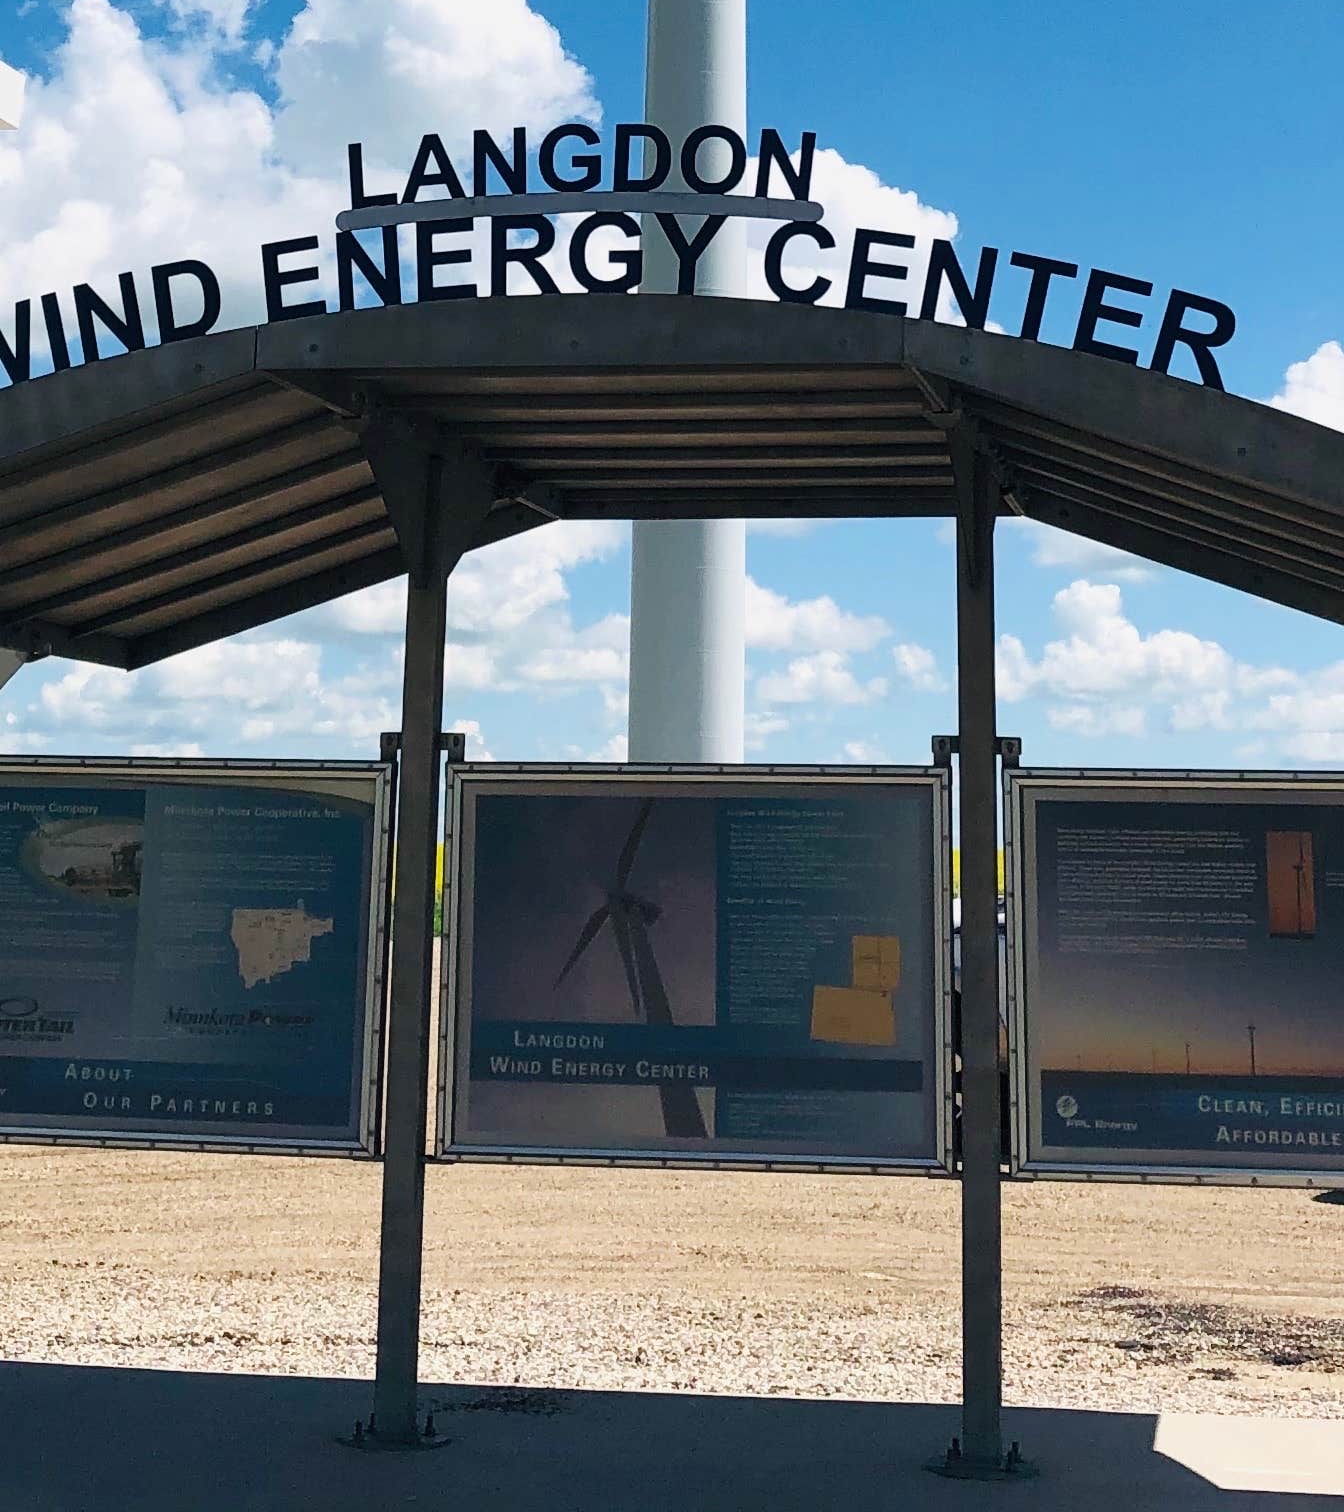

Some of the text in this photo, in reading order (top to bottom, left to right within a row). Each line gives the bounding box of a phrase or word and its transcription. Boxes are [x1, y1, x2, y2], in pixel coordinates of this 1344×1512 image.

[346, 122, 819, 209] LANGDON
[260, 210, 729, 324] ENERGY
[762, 219, 1237, 391] CENTER
